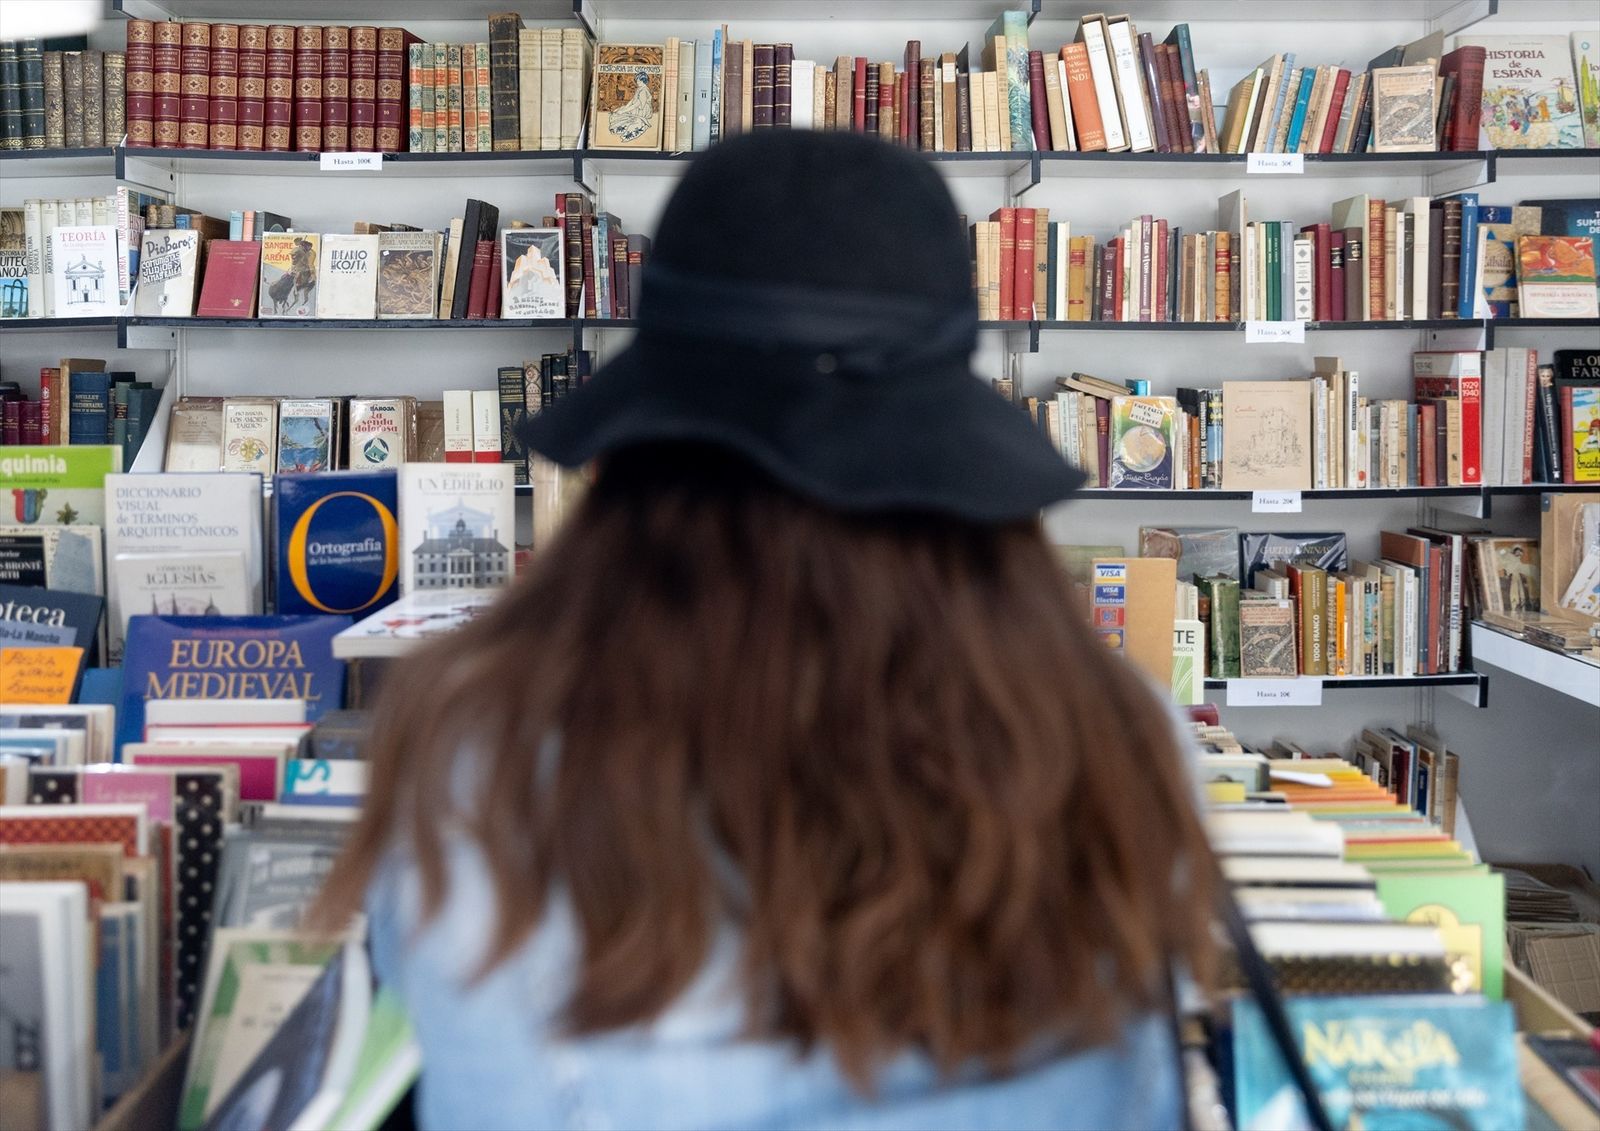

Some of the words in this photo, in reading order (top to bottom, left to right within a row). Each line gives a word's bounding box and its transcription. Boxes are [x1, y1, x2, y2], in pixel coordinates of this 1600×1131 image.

[1486, 50, 1545, 59] HISTORIA
[1492, 68, 1542, 78] ESPAÑA
[118, 189, 126, 241] ARQUITECTURA
[60, 231, 106, 242] TEORÍA
[332, 251, 367, 259] IDEARIO
[0, 257, 27, 266] UITEC
[336, 261, 367, 270] COSTA
[1, 454, 67, 477] quimia
[418, 479, 438, 491] UN
[442, 478, 504, 491] EDIFICIO
[116, 488, 202, 498] DICCIONARIO
[116, 502, 160, 511] VISUAL
[116, 514, 128, 524] de
[133, 512, 198, 524] TÉRMINOS
[309, 538, 382, 555] Ortografía
[320, 557, 327, 565] la
[328, 556, 351, 566] lengua
[352, 554, 382, 564] española
[25, 630, 60, 644] Mancha
[1174, 630, 1194, 644] TE
[168, 639, 305, 668] EUROPA
[144, 672, 321, 700] MEDIEVAL
